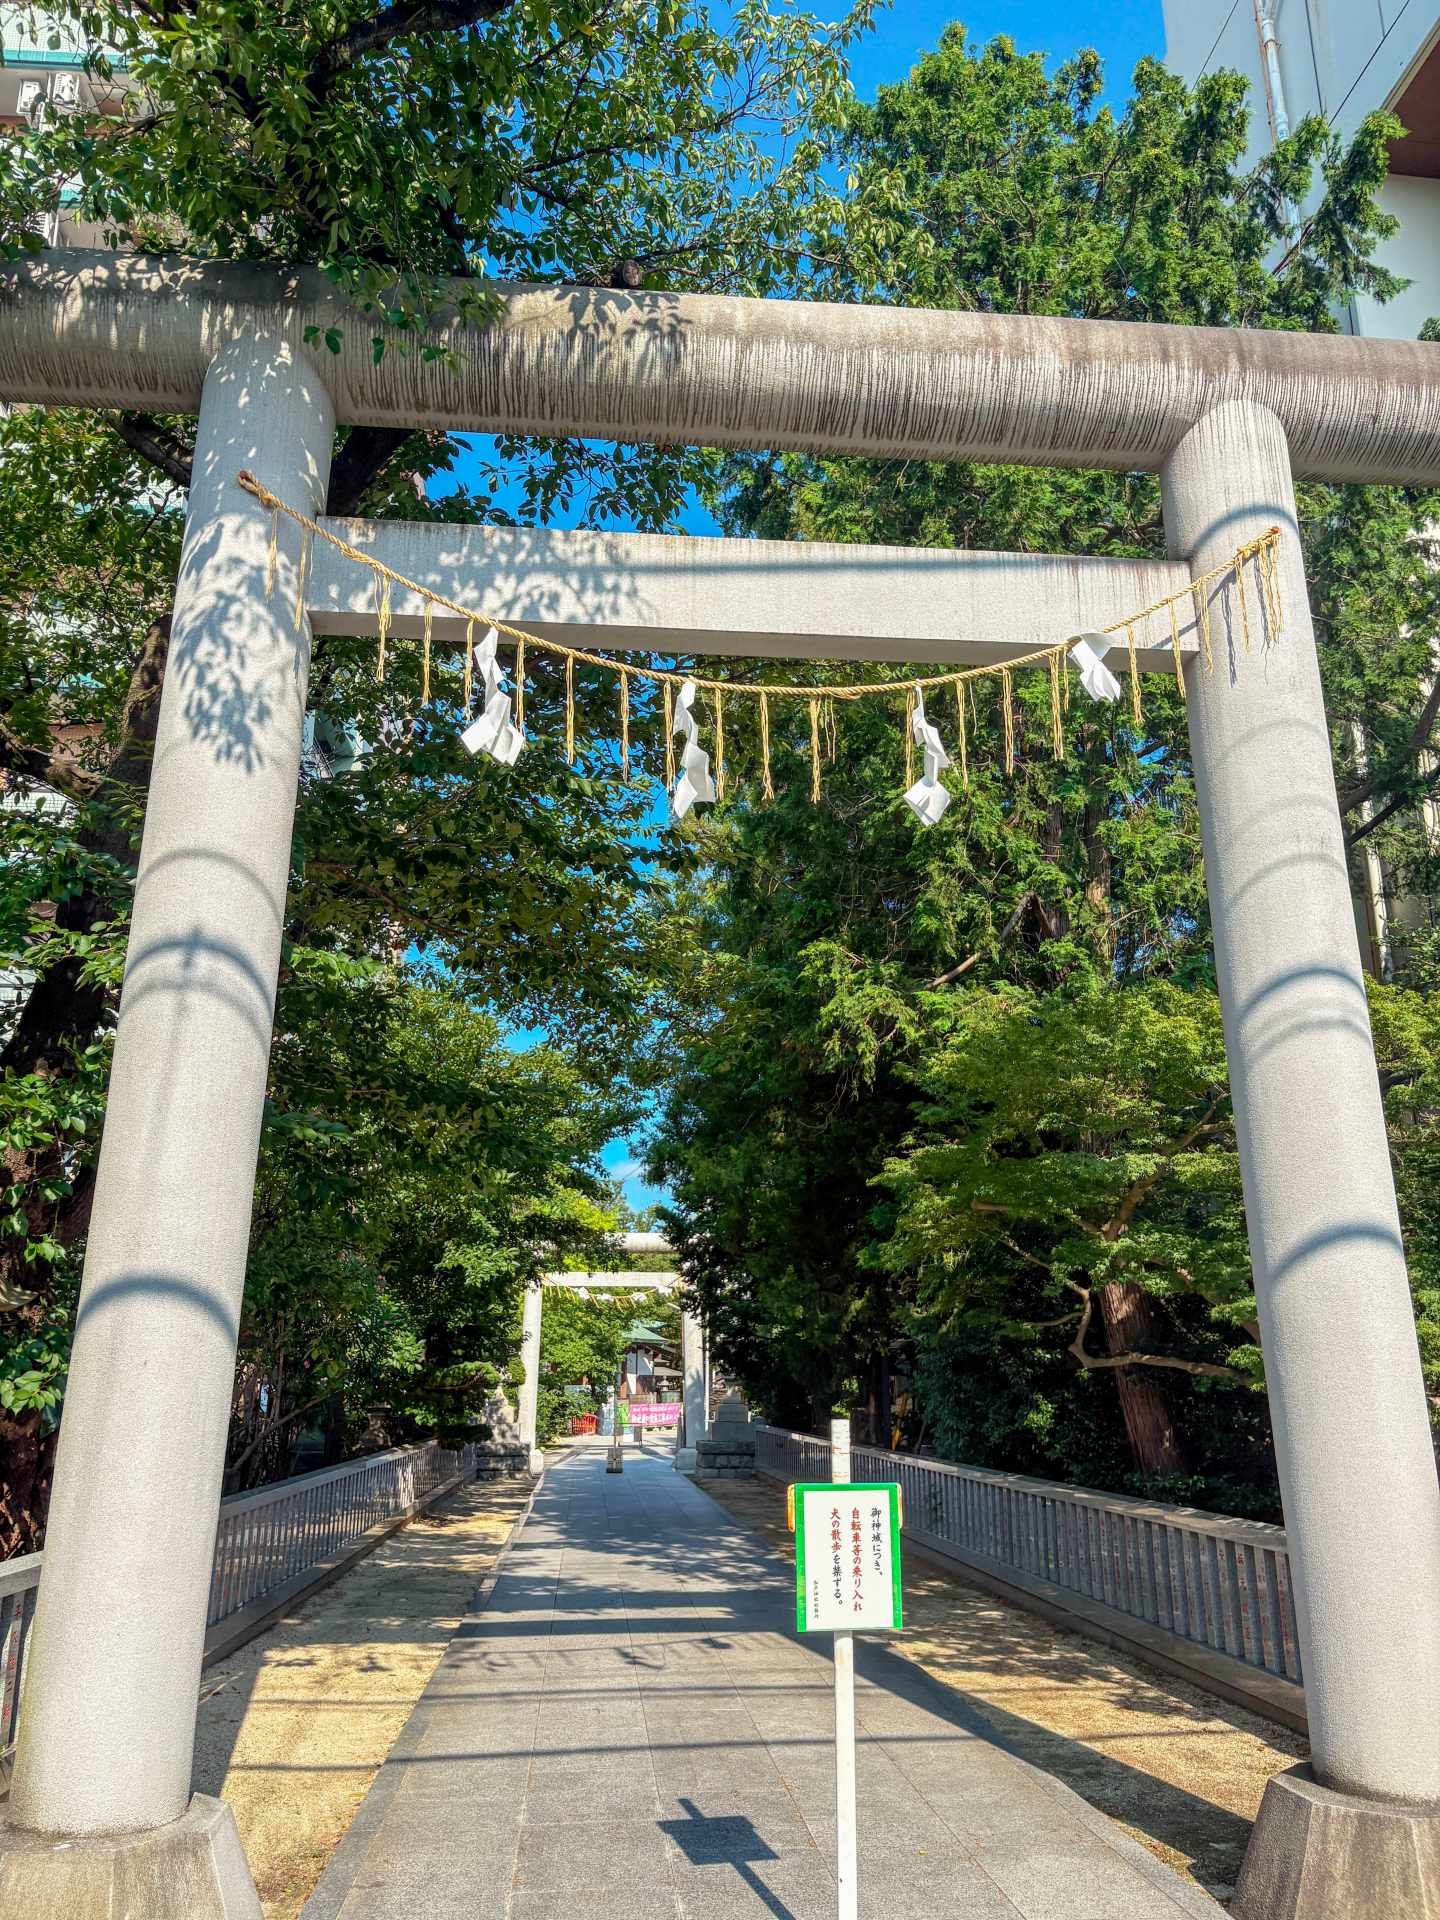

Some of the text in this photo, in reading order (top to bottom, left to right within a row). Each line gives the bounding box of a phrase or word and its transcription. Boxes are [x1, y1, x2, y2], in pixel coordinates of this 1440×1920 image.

[830, 1508, 843, 1605] 犬の散歩を禁ずる。
[850, 1507, 864, 1612] 自転車等の乗り入れ
